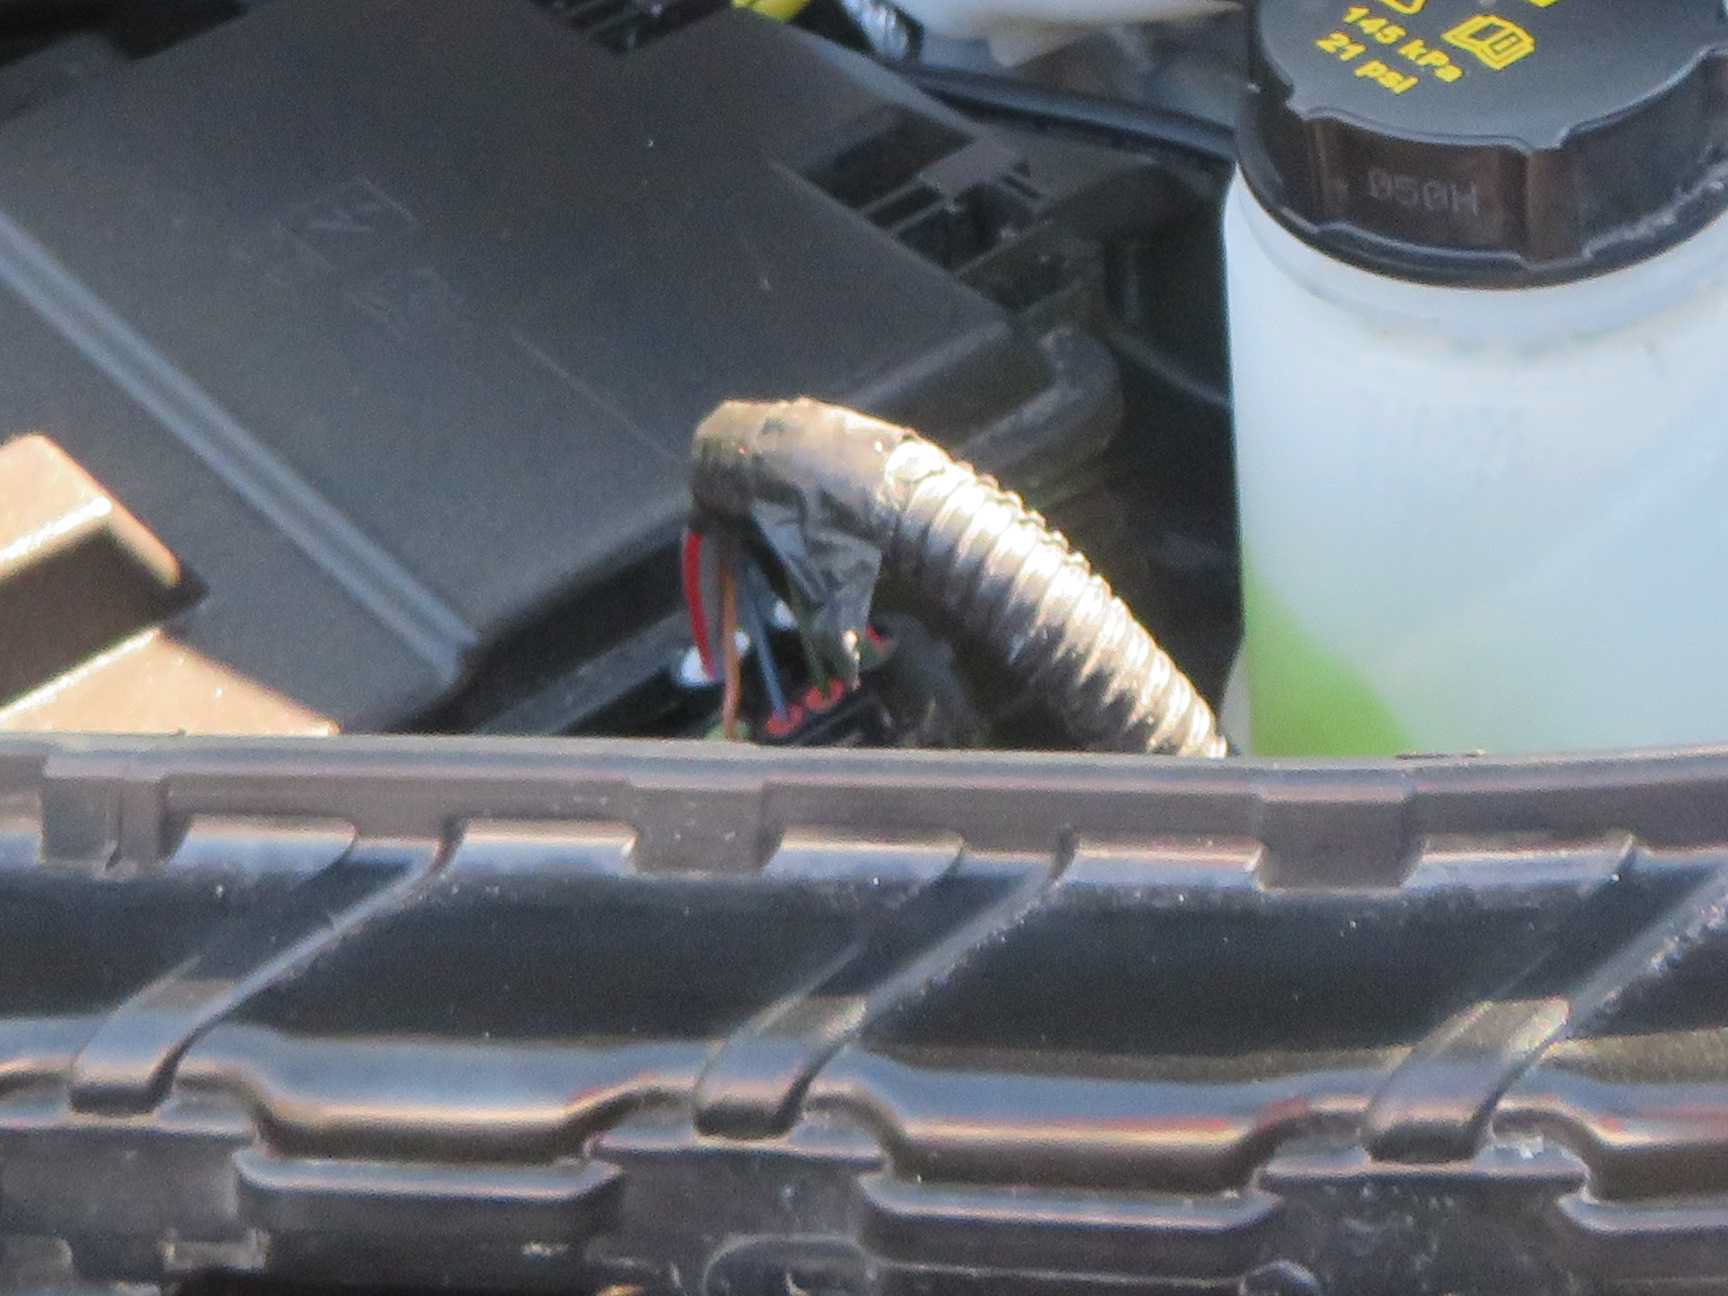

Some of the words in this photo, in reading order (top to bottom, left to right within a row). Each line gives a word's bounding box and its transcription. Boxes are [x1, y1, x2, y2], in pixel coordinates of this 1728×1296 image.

[1343, 5, 1408, 45] 145
[1314, 31, 1367, 61] 21
[1353, 59, 1419, 95] psi
